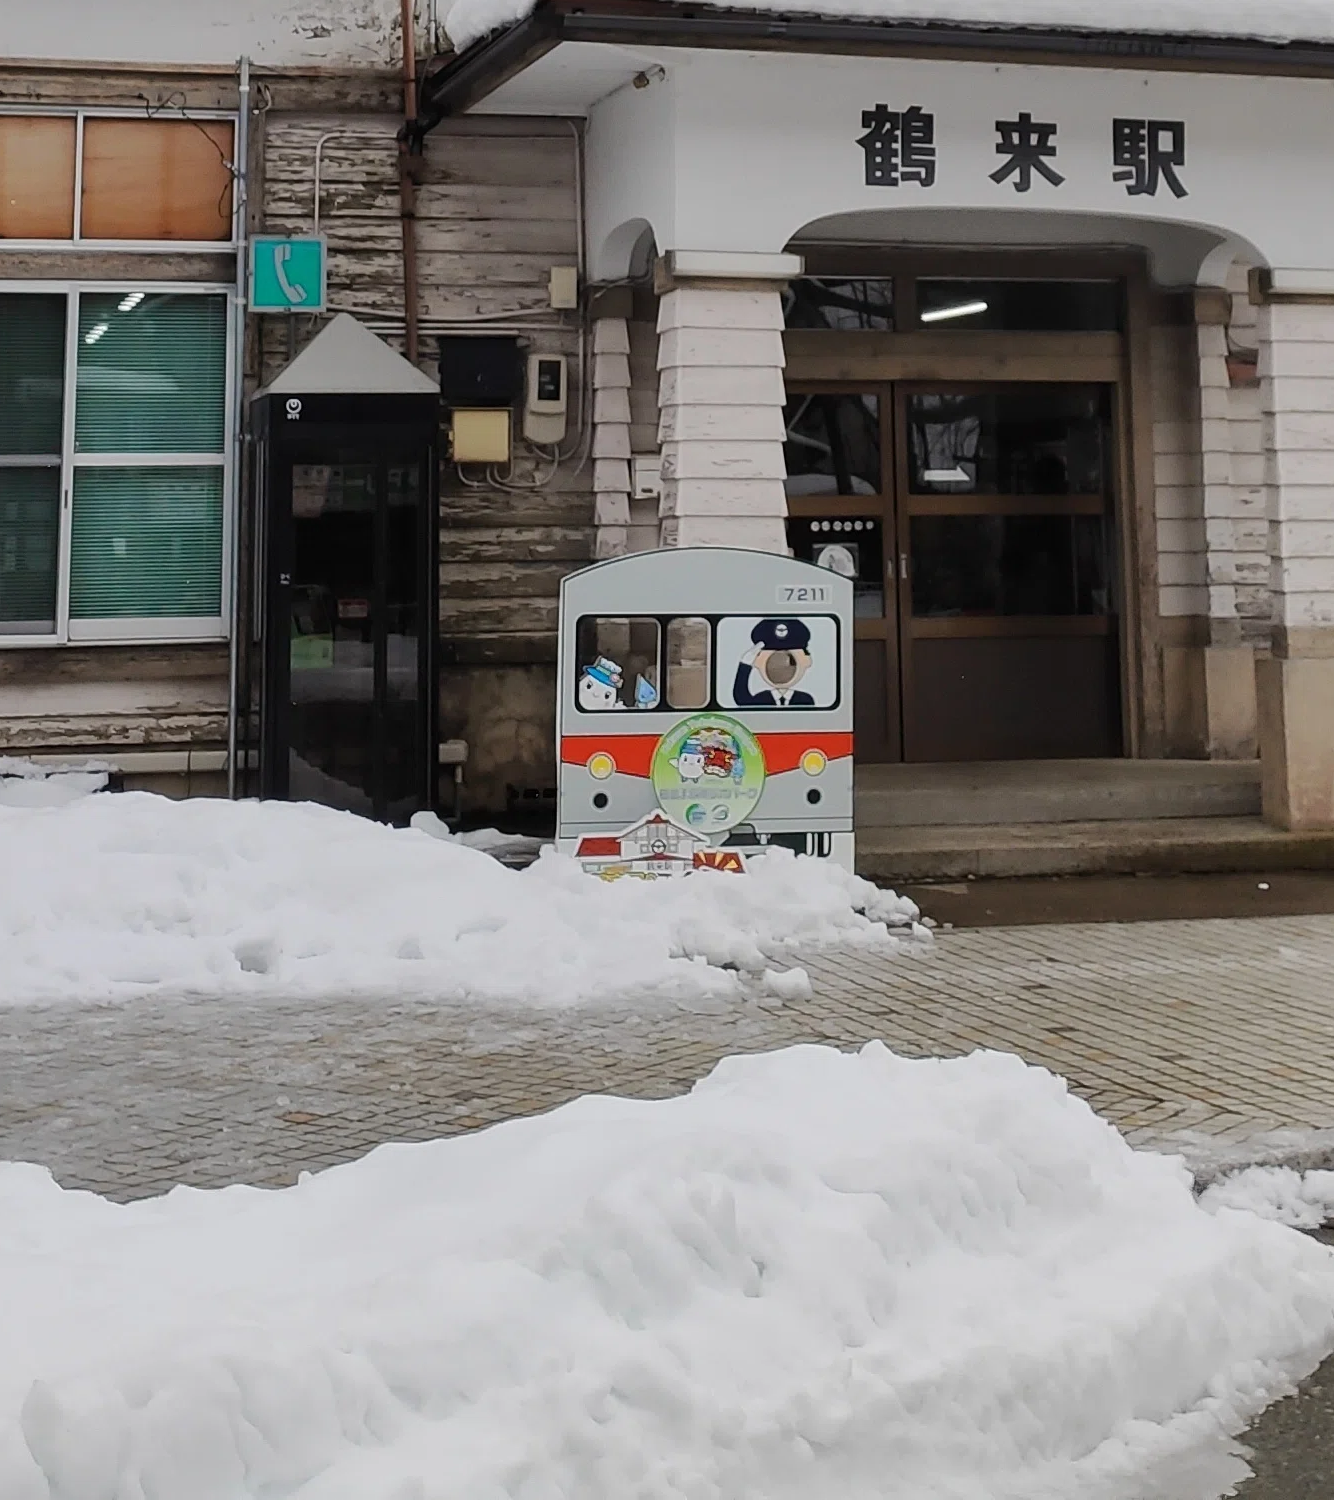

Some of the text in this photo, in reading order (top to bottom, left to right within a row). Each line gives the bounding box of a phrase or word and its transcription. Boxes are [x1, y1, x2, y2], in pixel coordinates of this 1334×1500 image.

[855, 103, 1189, 198] 鶴来駅
[784, 588, 824, 601] 7211
